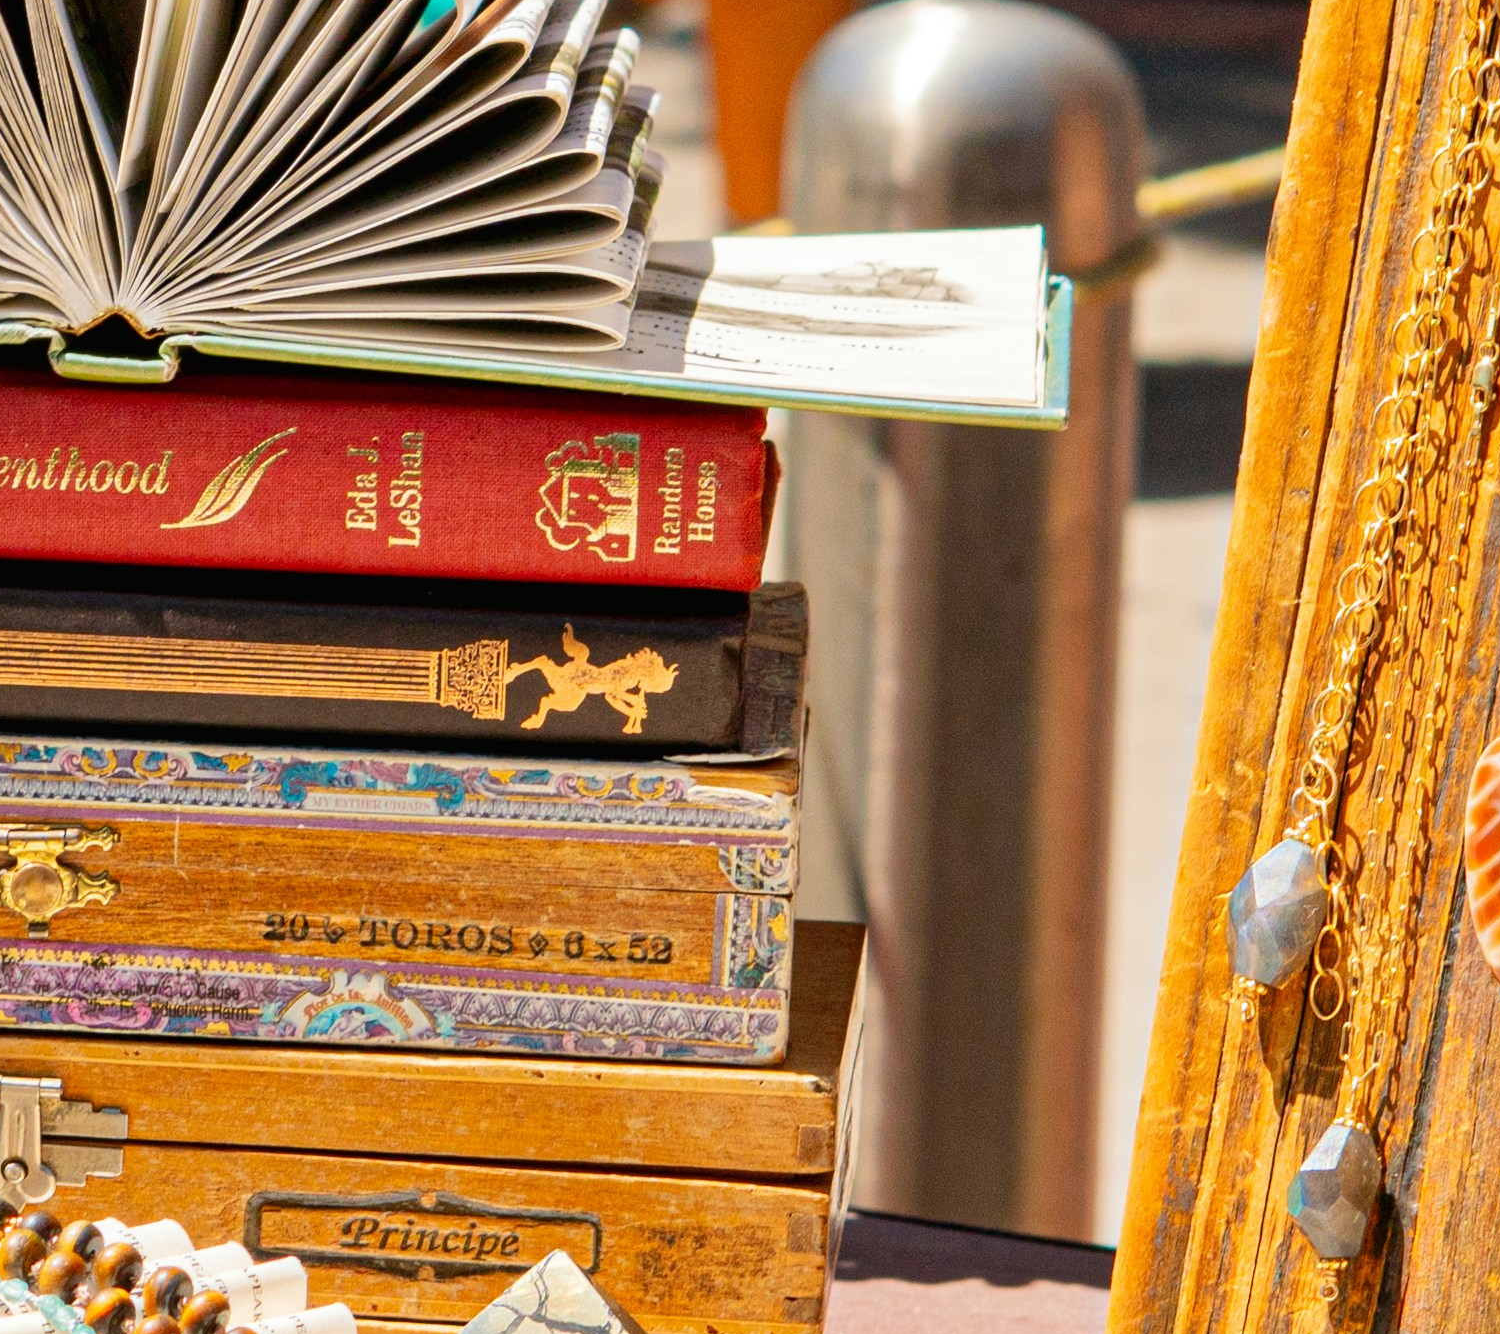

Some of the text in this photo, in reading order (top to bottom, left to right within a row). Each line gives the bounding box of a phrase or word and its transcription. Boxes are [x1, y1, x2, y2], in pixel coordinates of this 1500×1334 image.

[345, 435, 380, 533] Eda J.
[388, 430, 425, 550] LeShan
[653, 447, 685, 556] Random
[687, 461, 718, 543] House
[312, 796, 431, 811] MY FATHER CIGARS
[262, 912, 674, 965] 20 TOROS 6 x 52
[196, 981, 241, 1000] Cause
[211, 1007, 254, 1021] Harm.
[340, 1216, 521, 1261] Principe
